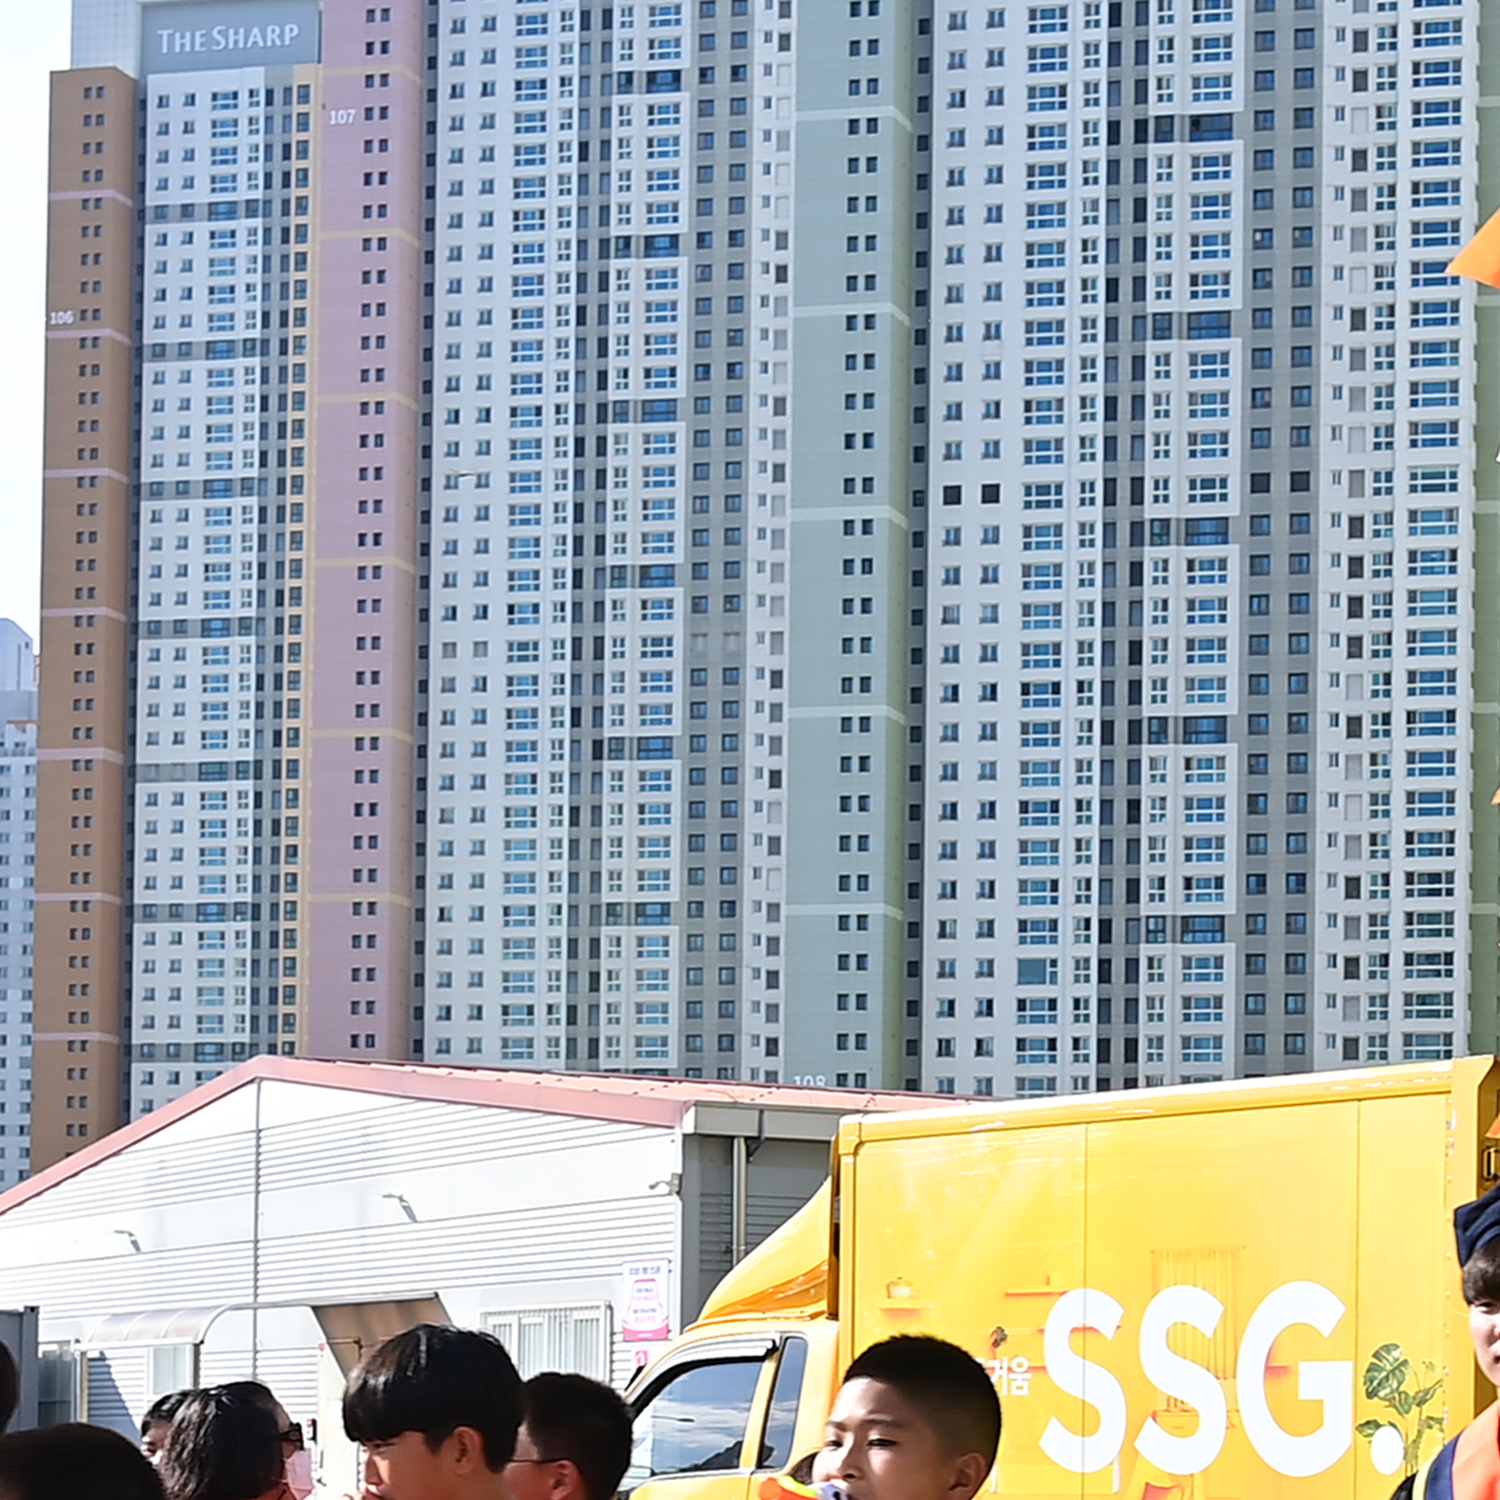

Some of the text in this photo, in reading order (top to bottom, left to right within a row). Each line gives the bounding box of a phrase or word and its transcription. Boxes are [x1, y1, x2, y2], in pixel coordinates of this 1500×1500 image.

[157, 24, 299, 53] THE SHARP
[329, 109, 356, 125] 107
[50, 310, 75, 325] 106
[975, 1356, 1032, 1395] 거움
